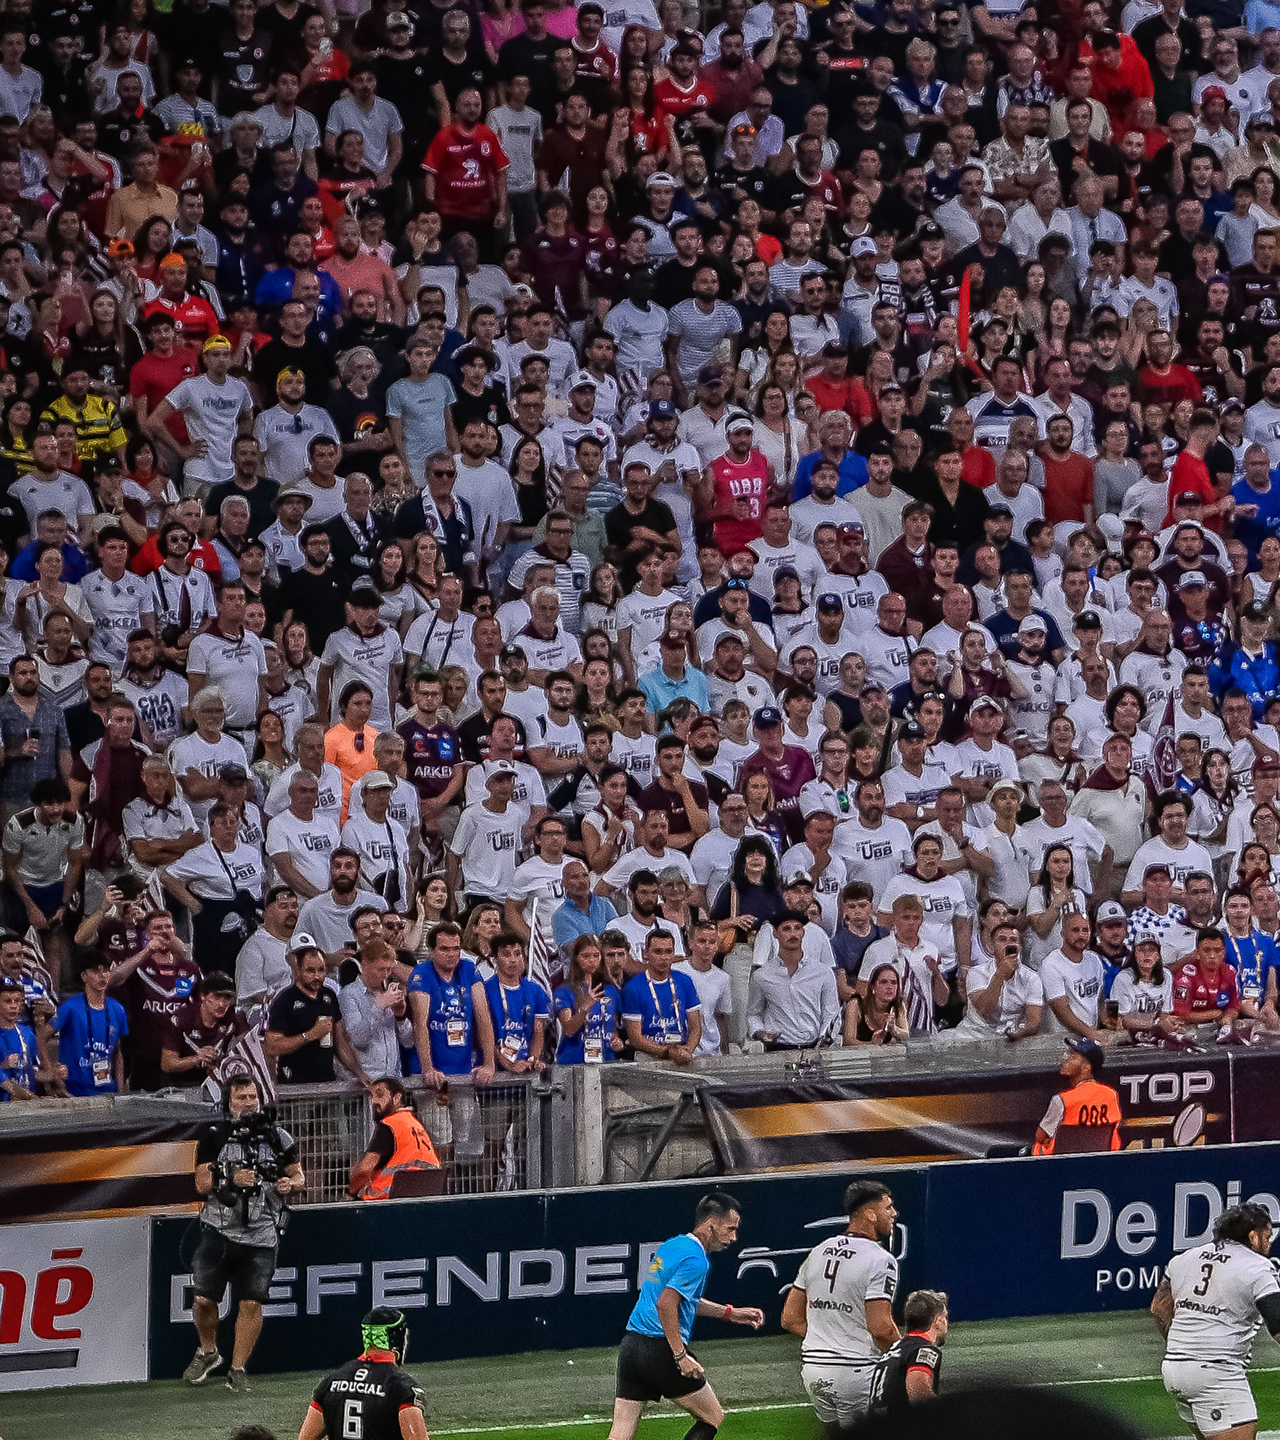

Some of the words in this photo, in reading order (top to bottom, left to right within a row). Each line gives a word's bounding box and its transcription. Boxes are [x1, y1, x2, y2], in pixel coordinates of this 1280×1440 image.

[862, 842, 892, 860] UBB
[1120, 1070, 1215, 1105] TOP
[1061, 1188, 1158, 1261] De
[823, 1248, 857, 1261] FAYAT
[1200, 1251, 1231, 1264] FAYAT
[170, 1241, 667, 1324] DEFENDE
[824, 1259, 840, 1293] 4
[1193, 1263, 1214, 1297] 3
[330, 1380, 386, 1398] FIDUCIAL
[342, 1398, 363, 1440] 6
